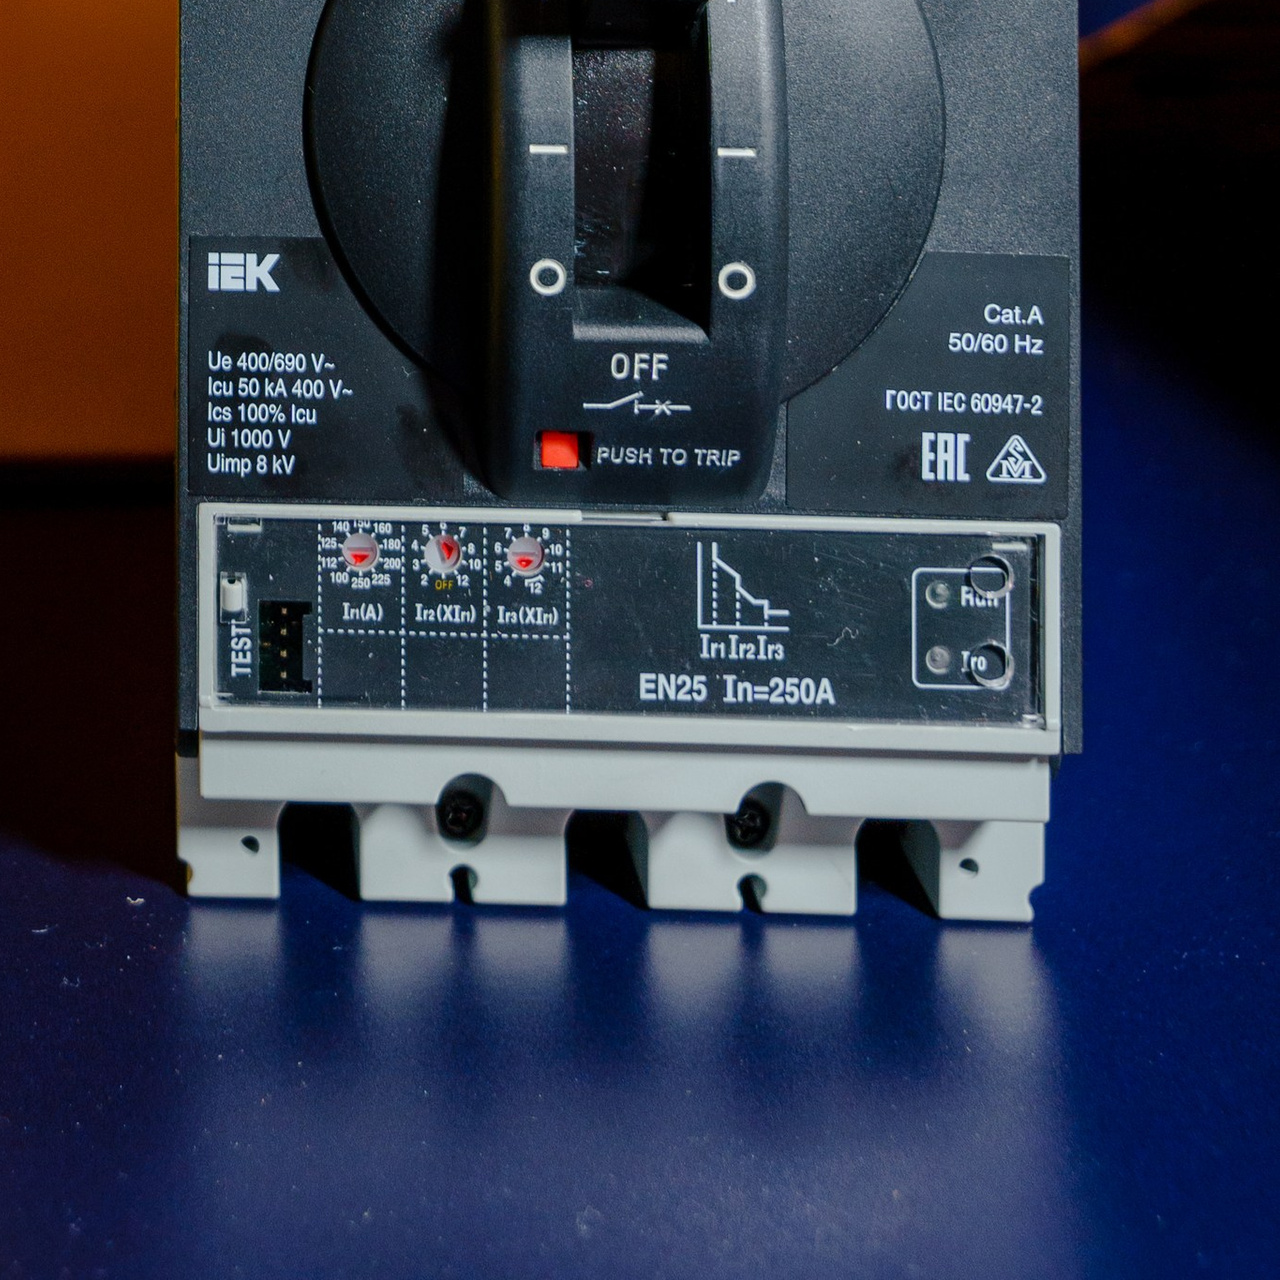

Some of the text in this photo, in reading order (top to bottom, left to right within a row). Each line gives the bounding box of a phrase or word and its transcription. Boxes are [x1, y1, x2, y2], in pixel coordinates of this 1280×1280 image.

[983, 303, 1045, 326] Cat.A
[948, 332, 1044, 355] 50/60 Hz
[208, 350, 232, 372] Ue
[236, 351, 307, 373] 400/690
[610, 352, 669, 381] OFF
[208, 376, 233, 397] Icu
[238, 378, 260, 397] 50
[264, 378, 288, 398] kA
[291, 379, 324, 399] 400
[885, 389, 1043, 415] ГОСТ IEC 60947-2
[208, 401, 318, 424] Ics 100% Icu
[208, 427, 291, 450] Ui 1000 V
[596, 446, 741, 467] PUSH TO TRIP
[921, 431, 971, 482] EAC
[207, 452, 296, 477] Uimp 8 kV
[332, 521, 350, 533] 140
[373, 522, 392, 534] 160
[421, 524, 429, 536] 5
[458, 526, 467, 538] 7
[504, 527, 512, 539] 7
[542, 527, 550, 539] 9
[321, 537, 337, 549] 125
[382, 538, 401, 550] 180
[411, 539, 419, 551] 4
[467, 543, 475, 555] 8
[494, 542, 502, 554] 6
[549, 544, 563, 556] 10
[321, 557, 337, 568] 112
[383, 558, 401, 570] 200
[412, 559, 420, 571] 3
[469, 559, 482, 570] 10
[494, 560, 502, 572] 5
[551, 561, 563, 573] 11
[330, 571, 349, 583] 100
[351, 577, 371, 589] 250
[371, 574, 391, 586] 225
[420, 574, 429, 586] 2
[456, 574, 469, 586] 12
[503, 575, 512, 587] 4
[435, 579, 453, 590] OFF
[529, 582, 542, 594] 12
[230, 618, 252, 677] TEST
[639, 672, 836, 705] EN25 In=250A
